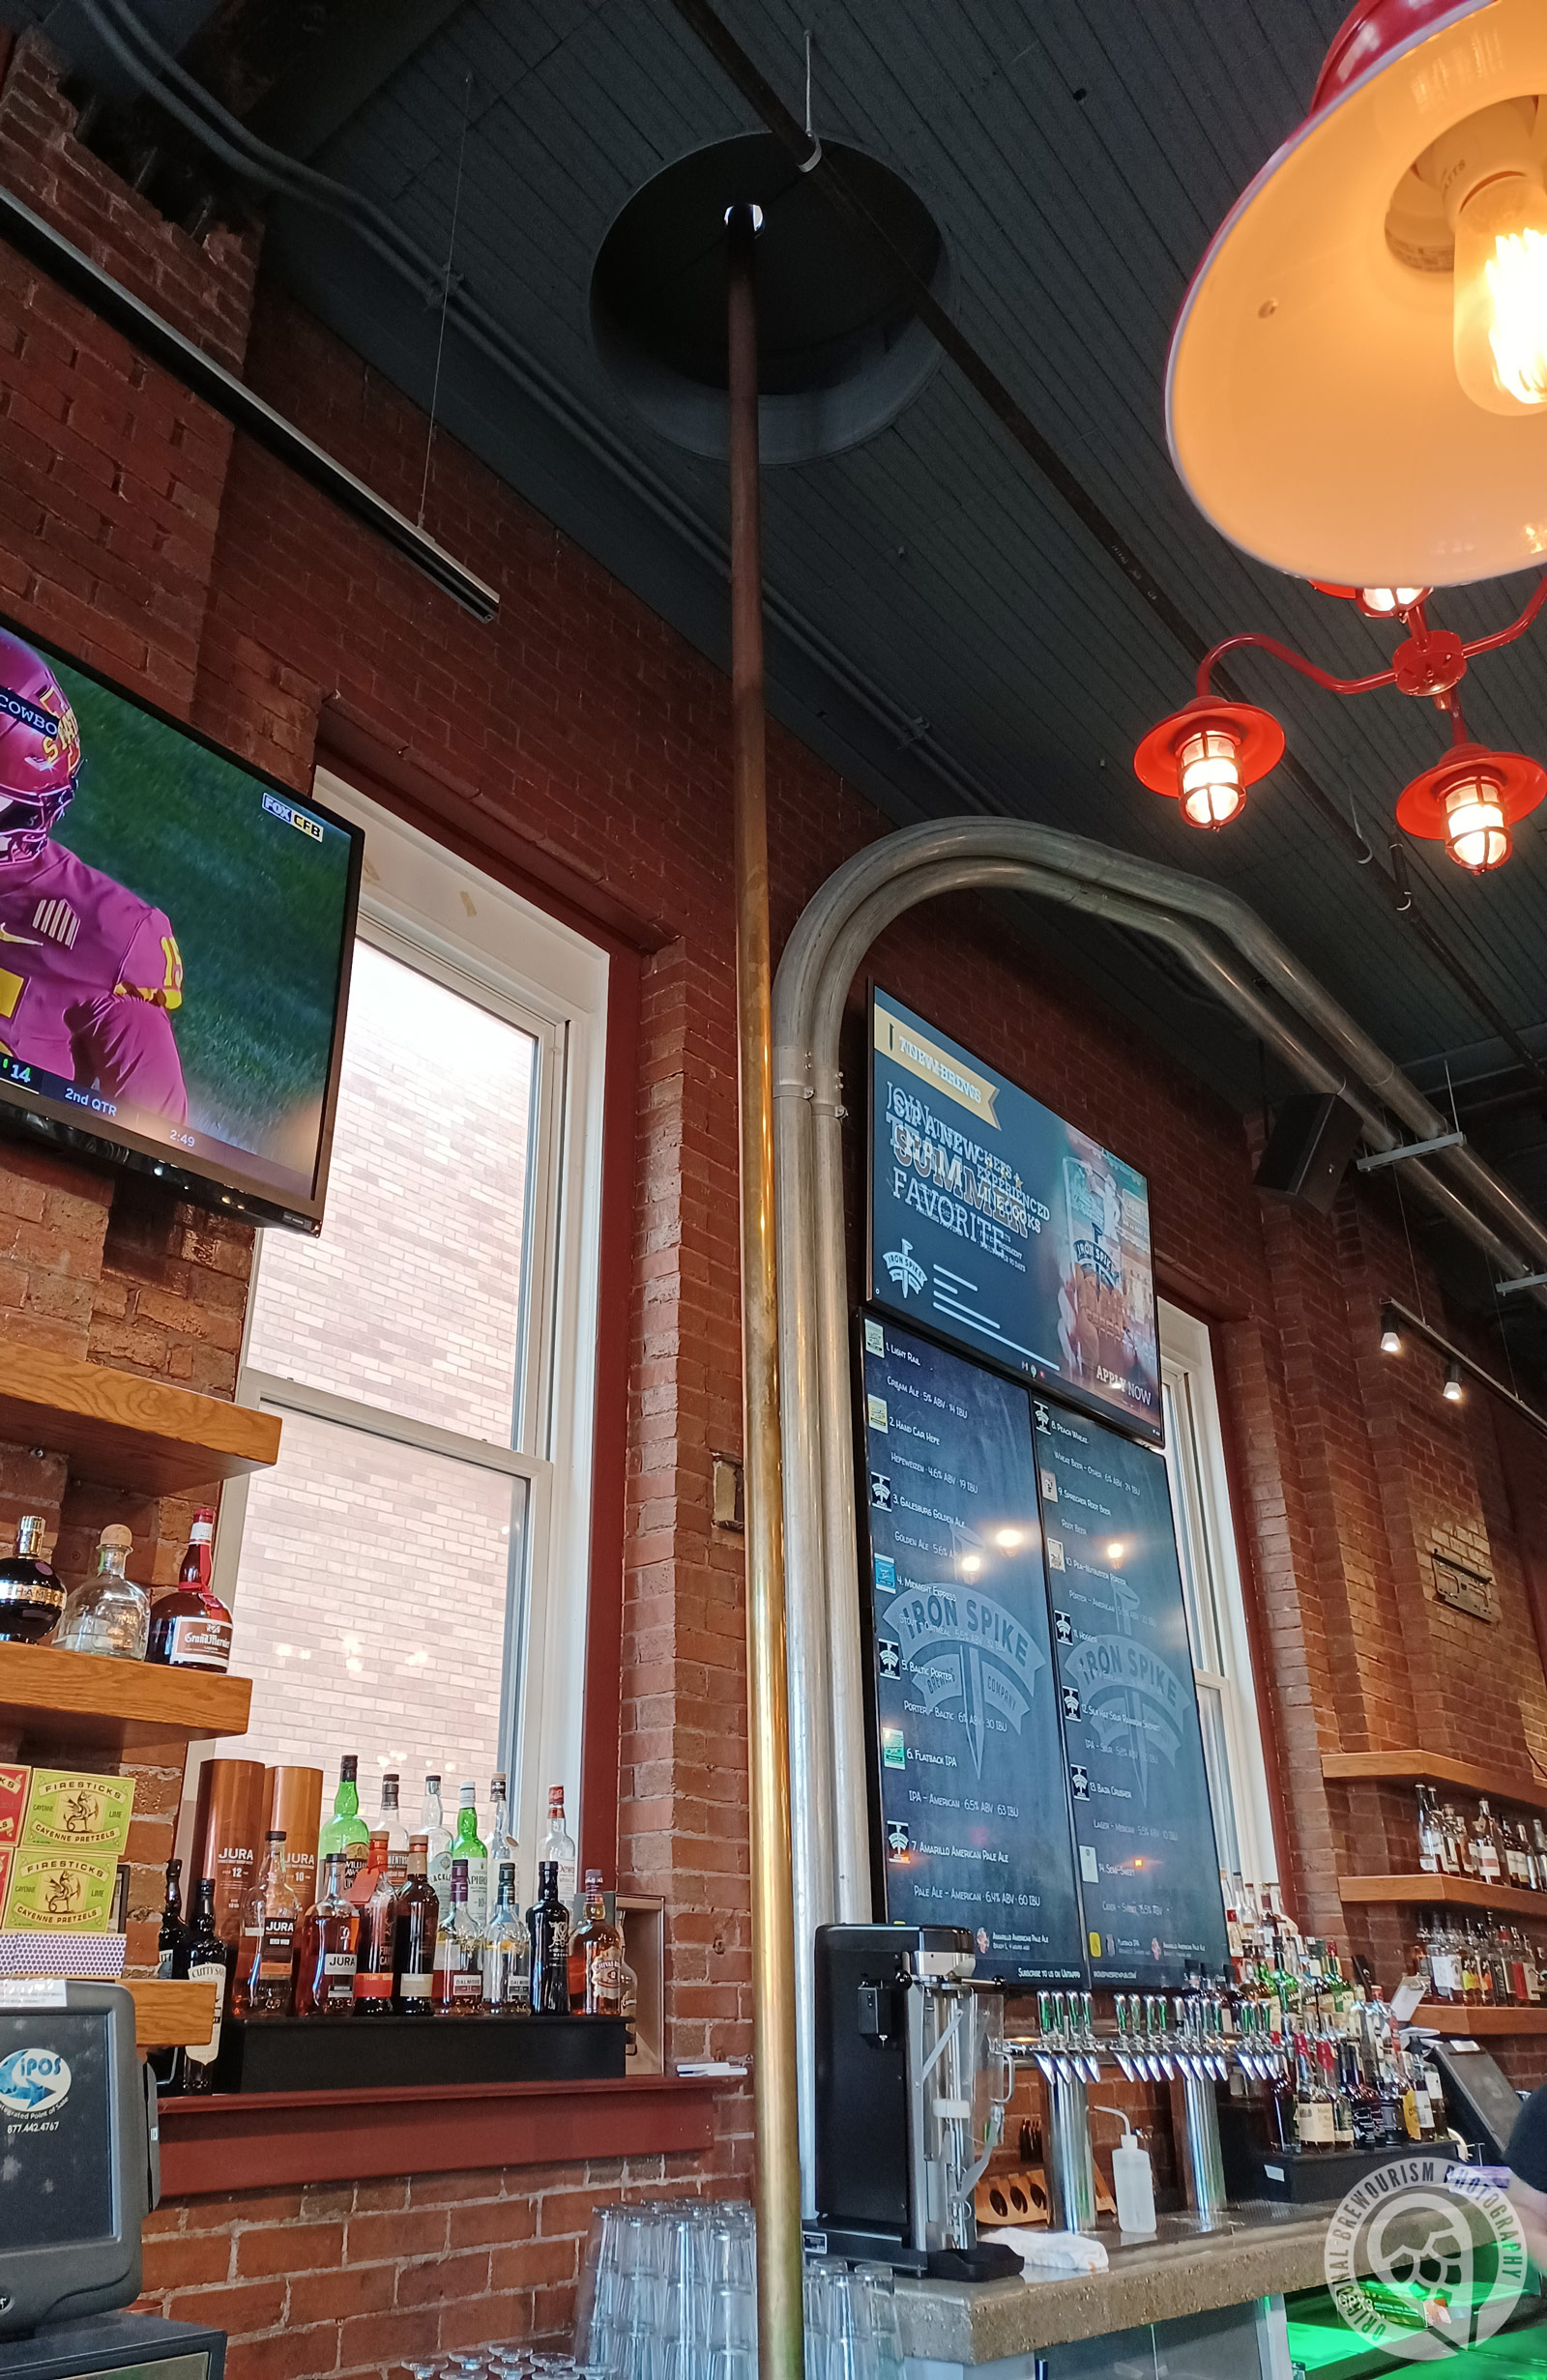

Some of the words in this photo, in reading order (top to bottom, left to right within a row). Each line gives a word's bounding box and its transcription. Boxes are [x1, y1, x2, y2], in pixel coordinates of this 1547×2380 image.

[264, 798, 291, 821] FOX
[293, 814, 321, 838] CFB
[10, 1064, 31, 1084] 14
[64, 1088, 89, 1106] 2nd
[91, 1098, 117, 1117] QTR
[169, 1129, 195, 1147] 2:49
[977, 1163, 1051, 1222] EXPERIENCED
[892, 1167, 1005, 1255] FAVORITE
[890, 1345, 907, 1359] LIGHT
[907, 1351, 921, 1366] RAIL
[1096, 1365, 1127, 1393] APPLY
[1127, 1382, 1152, 1406] NOW
[908, 1385, 919, 1398] ALE
[933, 1396, 946, 1408] ABV
[956, 1407, 968, 1419] IBU
[913, 1426, 925, 1440] CAR
[890, 1452, 924, 1473] HEFEWEIZEN
[943, 1472, 956, 1486] ABV
[967, 1481, 978, 1495] IBU
[900, 1497, 932, 1517] GALESBURG
[932, 1510, 953, 1525] GOLDEN
[954, 1516, 966, 1528] ALE
[894, 1531, 917, 1547] GOLDEN
[918, 1538, 929, 1552] ALE
[905, 1578, 932, 1594] MIDNIGHT
[932, 1586, 957, 1602] EXPRESS
[902, 1595, 959, 1640] IRON
[966, 1599, 1029, 1668] SPIKE
[910, 1662, 930, 1676] BALTIC
[930, 1668, 953, 1682] PORTER
[1079, 1644, 1123, 1685] IRON
[1127, 1648, 1178, 1707] SPIKE
[903, 1699, 927, 1716] PORTER
[934, 1707, 954, 1721] BALTIC
[996, 1720, 1007, 1732] IBU
[915, 1750, 945, 1766] FLATBACK
[945, 1756, 958, 1768] IPA
[45, 1781, 122, 1800] FIRESTICKS
[909, 1789, 921, 1803] IPA
[928, 1793, 960, 1809] AMERICAN
[980, 1802, 994, 1814] ABV
[997, 1804, 1007, 1816] 63
[1007, 1806, 1019, 1817] IBU
[35, 1824, 72, 1843] CAYENNE
[74, 1830, 115, 1843] PRETZELS
[218, 1847, 254, 1861] JURA
[285, 1853, 315, 1866] JURA
[919, 1842, 950, 1857] AMARILLO
[951, 1846, 981, 1860] AMERICAN
[982, 1850, 997, 1862] PALE
[997, 1851, 1009, 1864] ALE
[27, 1860, 103, 1878] FIRESTICKS
[232, 1867, 243, 1878] 12
[295, 1872, 305, 1881] 10
[914, 1885, 930, 1898] PALE
[931, 1887, 944, 1899] ALE
[950, 1890, 981, 1902] AMERICAN
[1001, 1893, 1015, 1905] ABV
[1018, 1894, 1029, 1906] 60
[1029, 1895, 1040, 1907] IBU
[17, 1905, 53, 1924] CAYENNE
[56, 1909, 98, 1924] PRETZELS
[265, 1921, 294, 1932] JURA
[329, 1956, 356, 1968] JURA
[191, 1967, 214, 1978] CUTTY
[20, 2057, 62, 2076] iPOS
[30, 2110, 47, 2120] Point
[7, 2121, 60, 2134] 877.442.4767
[1338, 2294, 1374, 2311] GPX3
